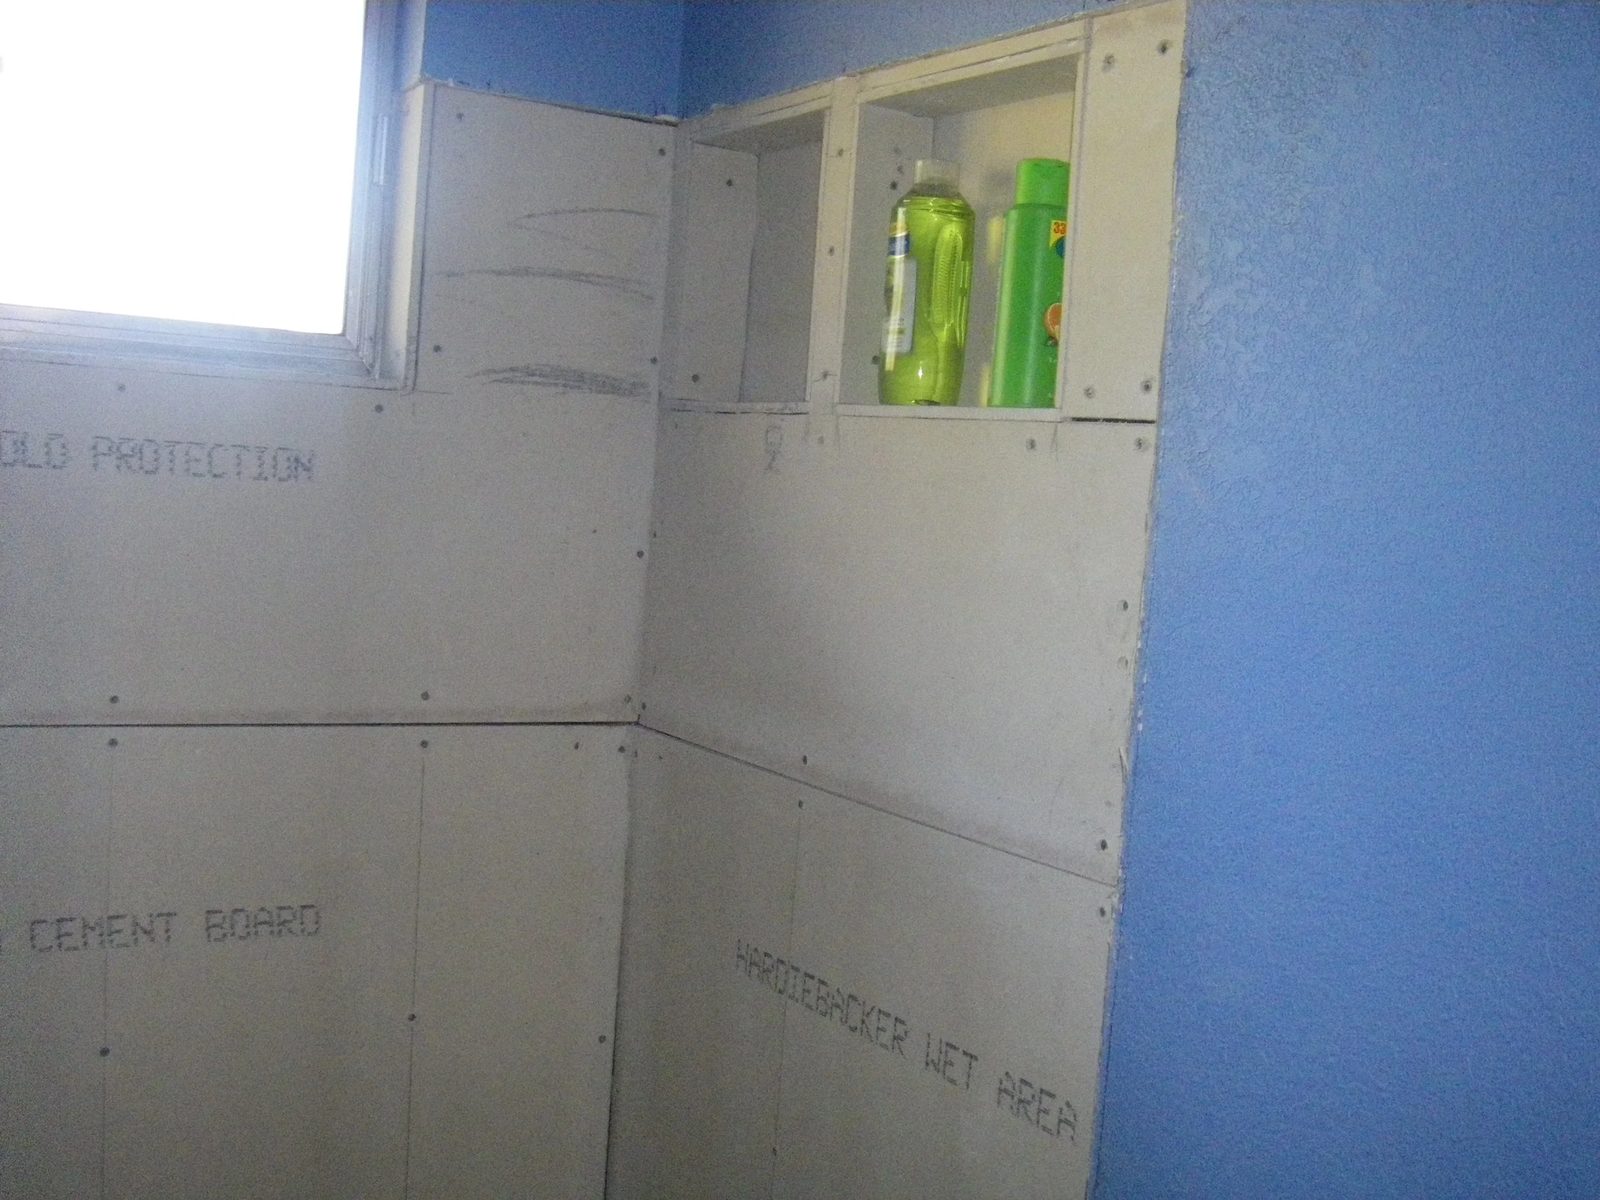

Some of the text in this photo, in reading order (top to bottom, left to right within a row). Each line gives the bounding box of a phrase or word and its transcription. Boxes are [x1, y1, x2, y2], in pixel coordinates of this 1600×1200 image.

[92, 435, 314, 483] PROTECTION
[29, 903, 321, 952] CEMENT BOARD
[735, 939, 1078, 1143] HARDIEBACKER WET AREA
